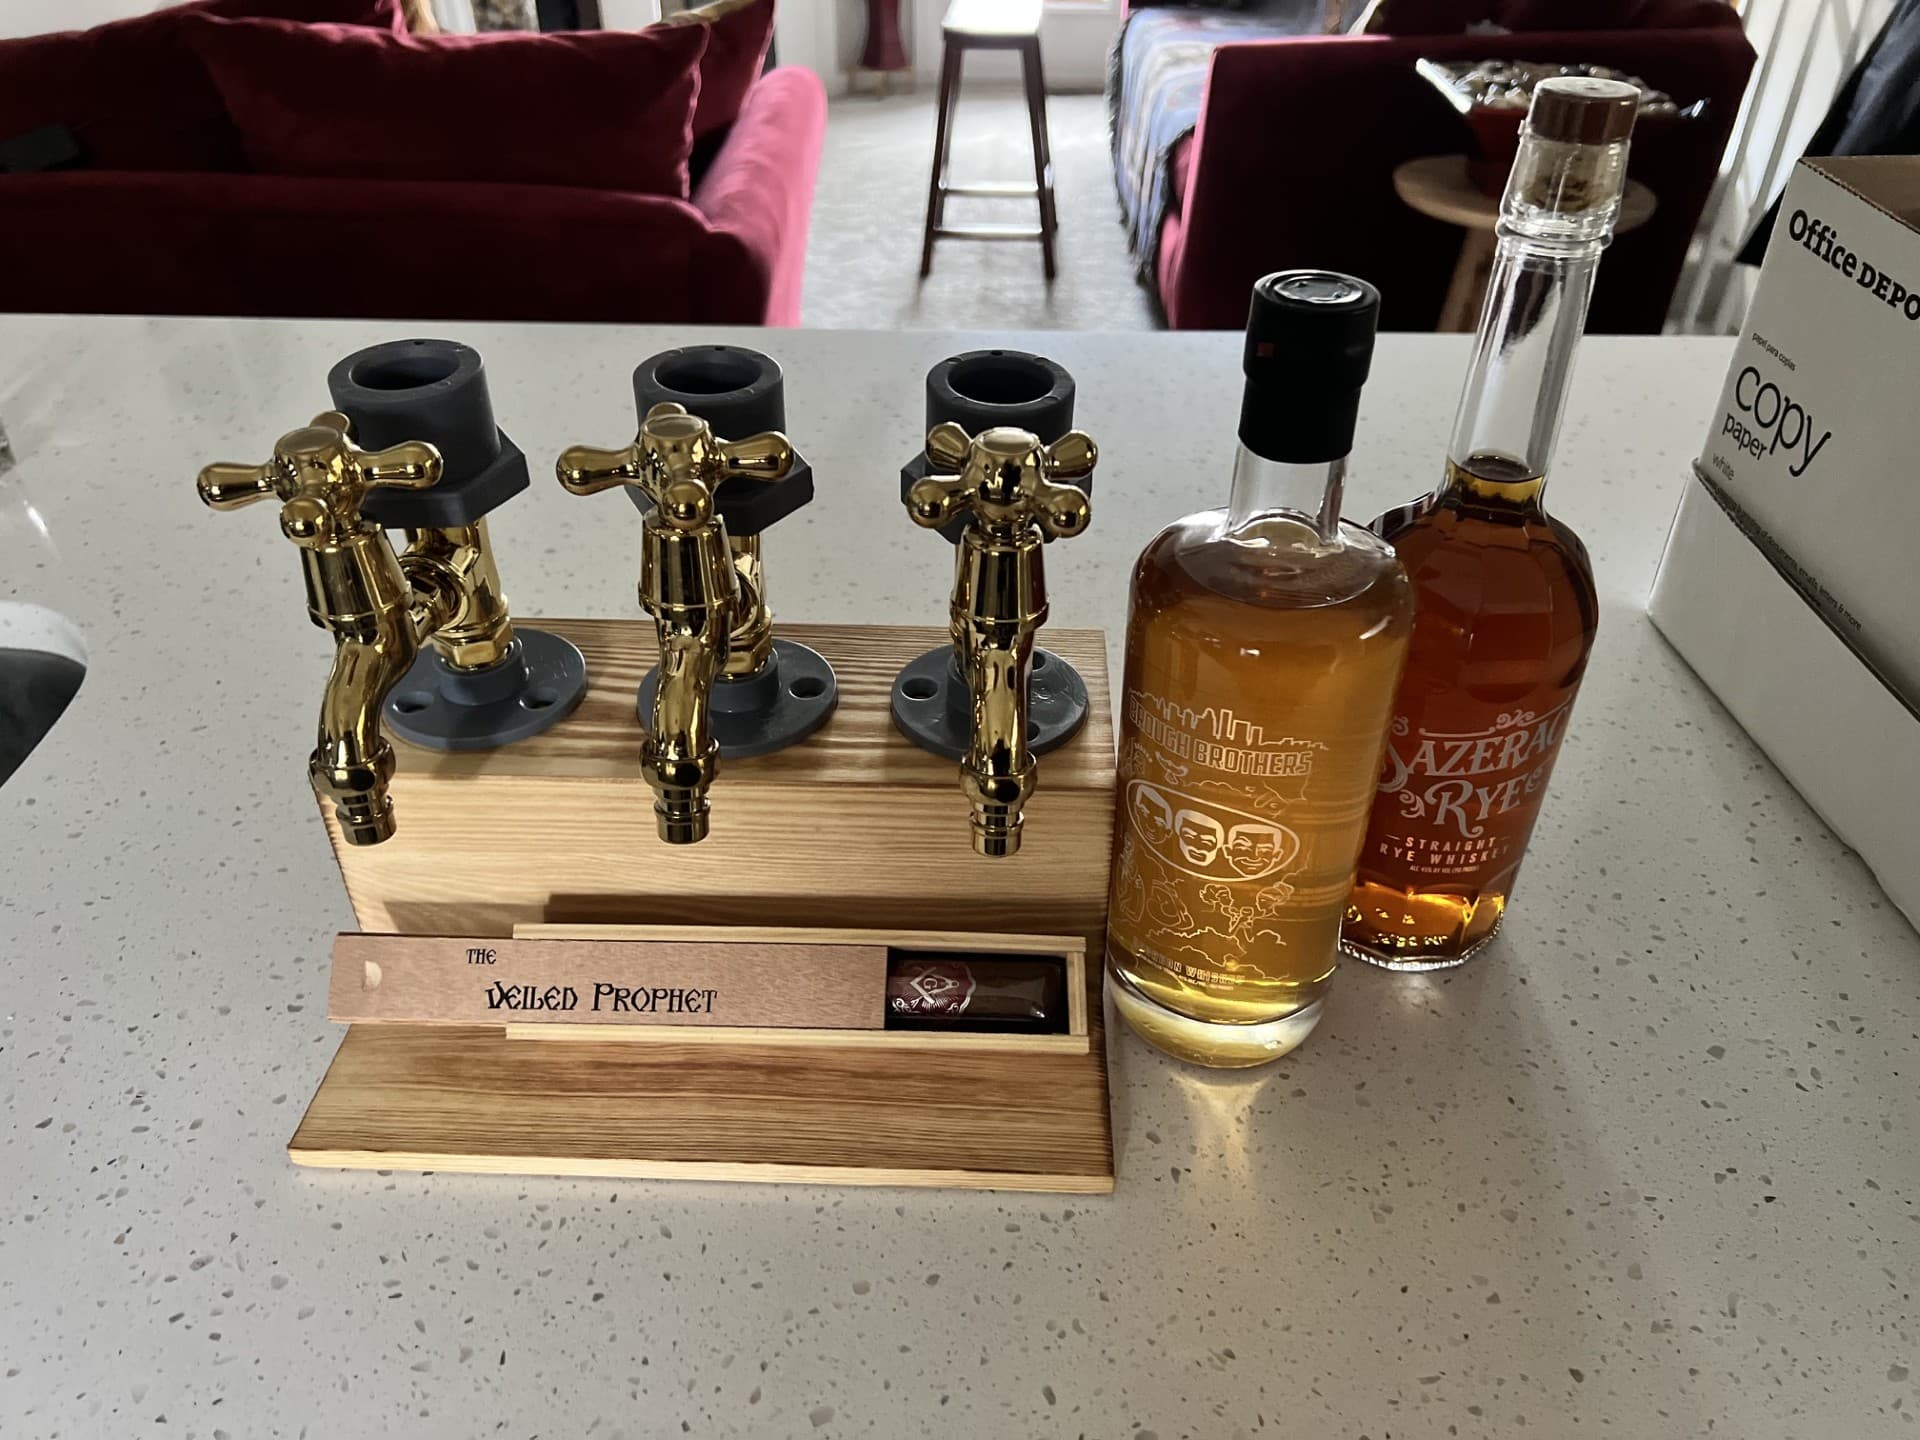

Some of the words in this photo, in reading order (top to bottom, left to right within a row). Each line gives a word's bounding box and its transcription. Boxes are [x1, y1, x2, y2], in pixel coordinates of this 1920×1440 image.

[1789, 209, 1857, 278] Office
[1735, 366, 1832, 477] copy
[1722, 412, 1768, 462] paper
[1713, 453, 1735, 481] white
[1192, 738, 1313, 776] BROTHERS
[1379, 842, 1416, 862] RYE
[1405, 836, 1497, 852] STRAIGHT
[466, 948, 497, 965] THE
[485, 981, 578, 1011] VEILED
